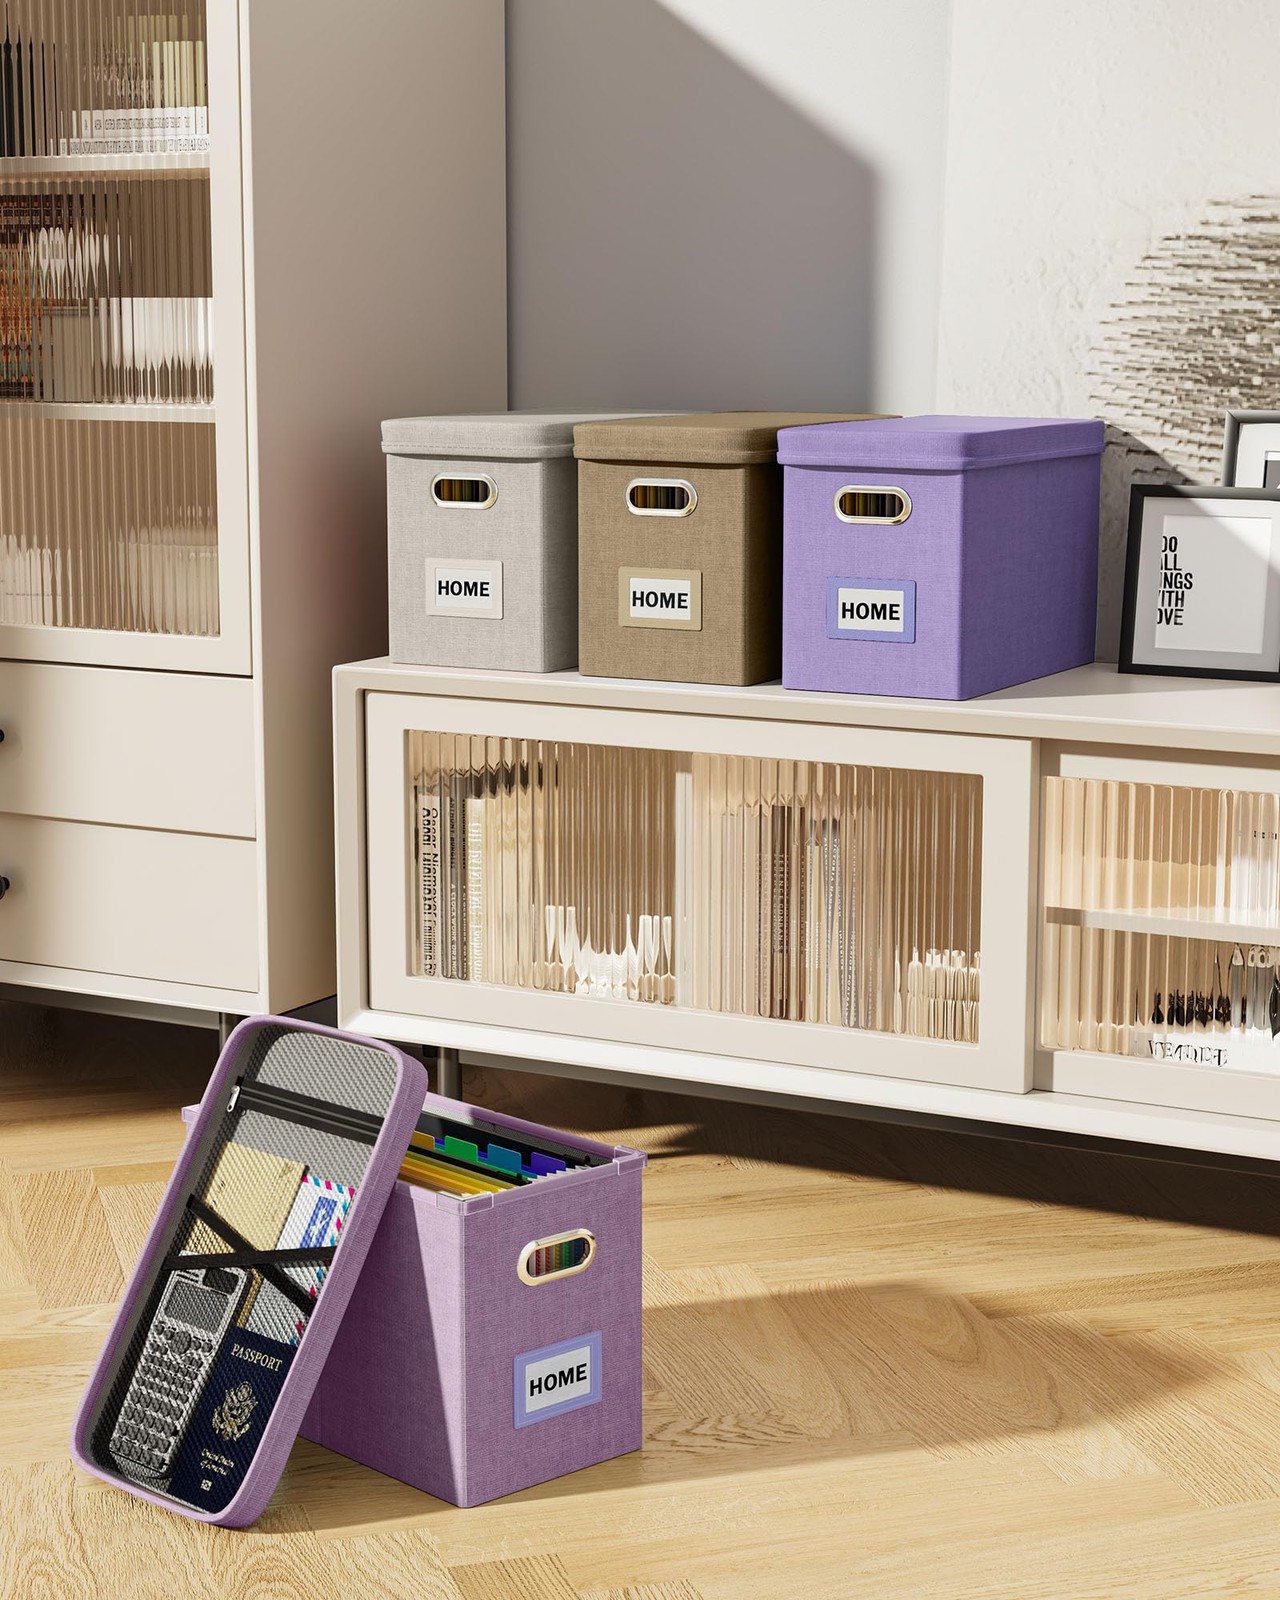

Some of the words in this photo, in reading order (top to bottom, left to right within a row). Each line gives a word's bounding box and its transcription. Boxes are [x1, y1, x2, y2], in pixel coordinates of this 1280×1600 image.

[438, 580, 490, 597] HOME
[632, 590, 689, 609] HOME
[1158, 589, 1185, 608] ITH
[842, 602, 900, 620] HOME
[231, 1343, 283, 1371] PASSPORT
[530, 1362, 587, 1397] HOME
